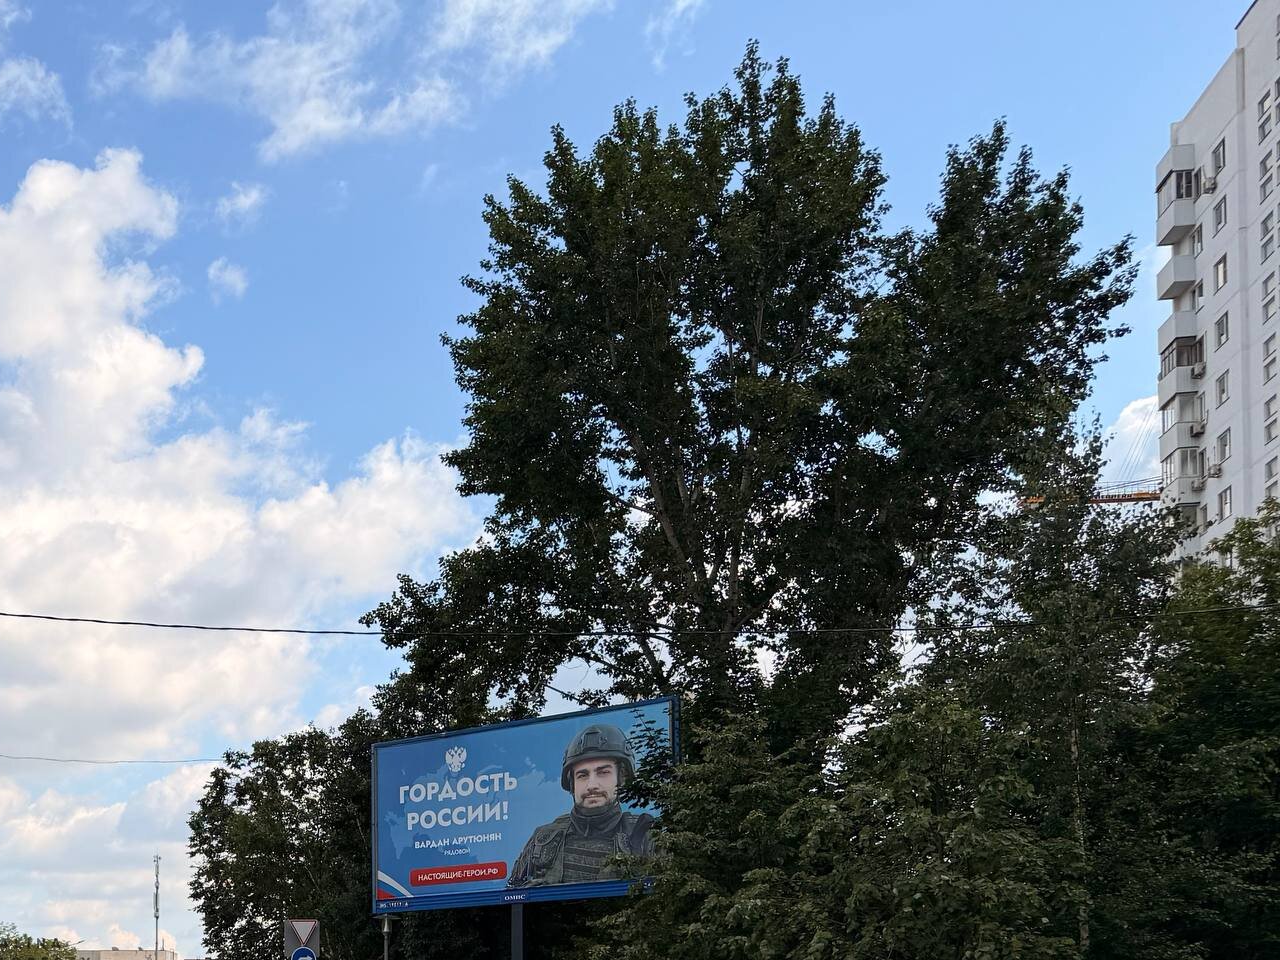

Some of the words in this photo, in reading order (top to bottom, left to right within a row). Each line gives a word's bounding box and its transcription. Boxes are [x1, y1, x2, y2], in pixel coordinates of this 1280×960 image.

[398, 772, 517, 804] ГОРДОСТЬ
[407, 801, 508, 831] РОССИИ!
[414, 838, 450, 849] ВАРДАН
[452, 832, 502, 846] АРУТЮНЯН
[418, 867, 499, 882] НАСТОЯЩИЕ-ГЕРОИ.РФ
